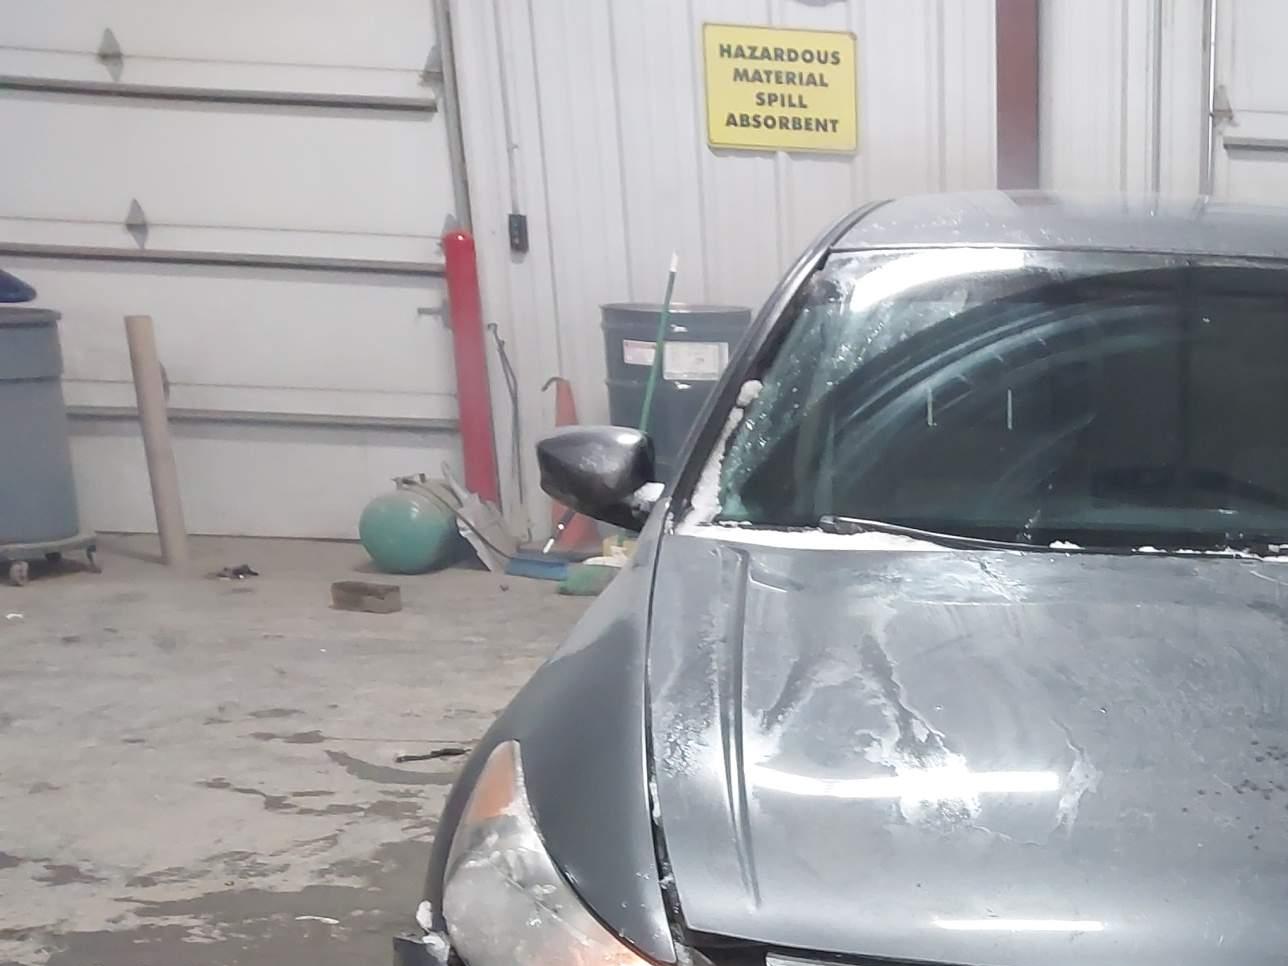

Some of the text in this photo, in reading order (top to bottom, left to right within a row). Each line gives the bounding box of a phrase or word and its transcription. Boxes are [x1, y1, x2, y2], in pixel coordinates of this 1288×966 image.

[719, 43, 841, 66] HAZARDOUS
[732, 67, 829, 88] MATERIAL
[755, 92, 808, 109] SPILL
[725, 112, 839, 133] ABSORBENT
